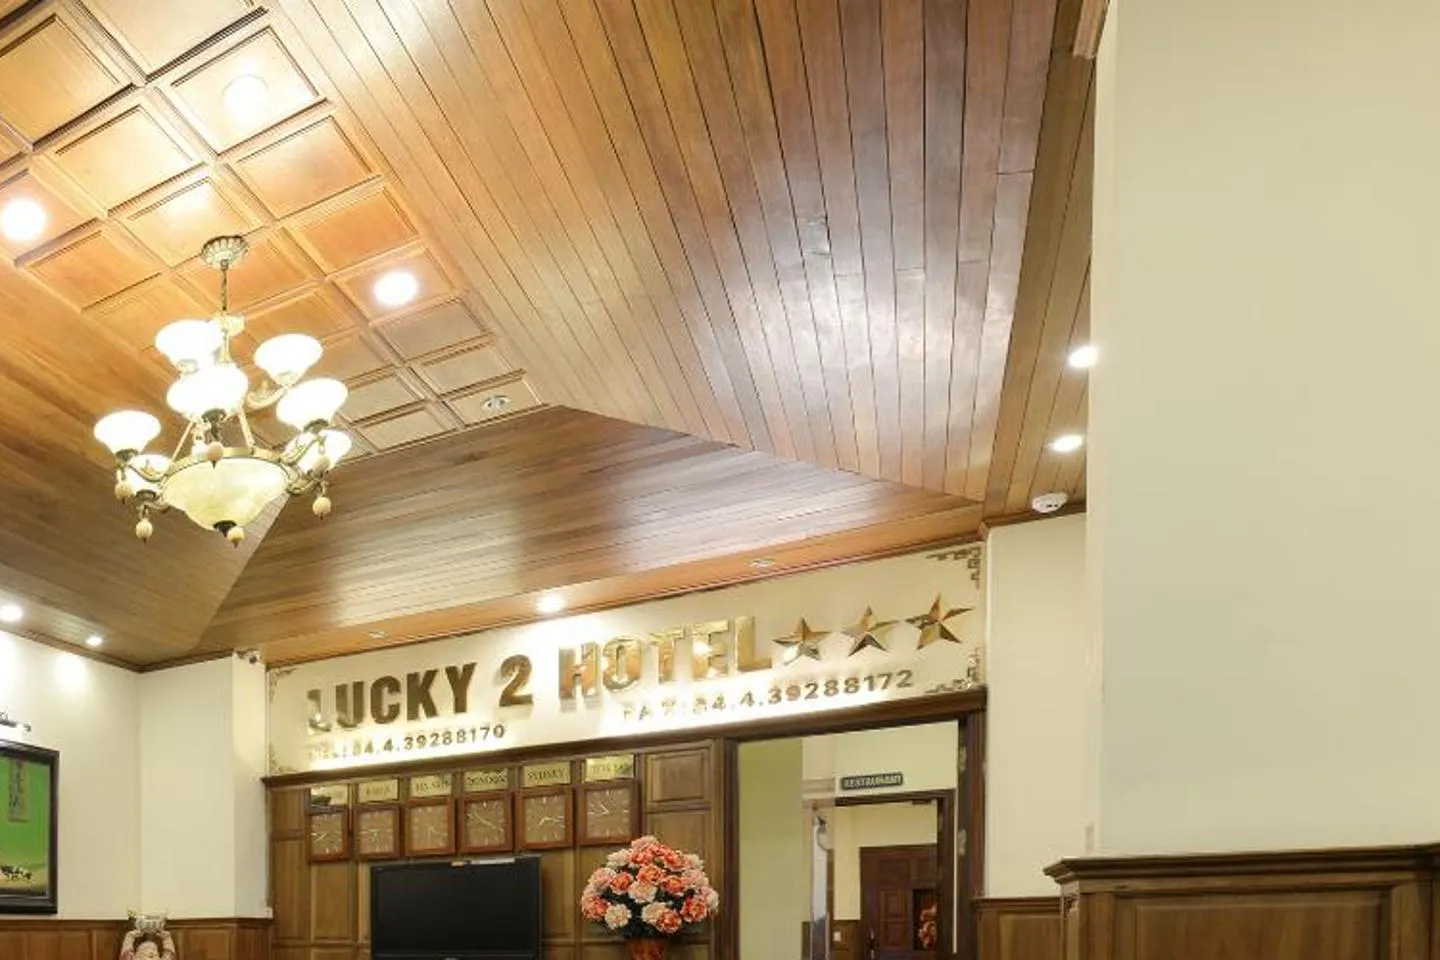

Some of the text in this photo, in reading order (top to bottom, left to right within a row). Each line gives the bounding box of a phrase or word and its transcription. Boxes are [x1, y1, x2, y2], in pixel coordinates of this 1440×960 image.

[307, 615, 773, 732] LUCKY 2 HOTEL
